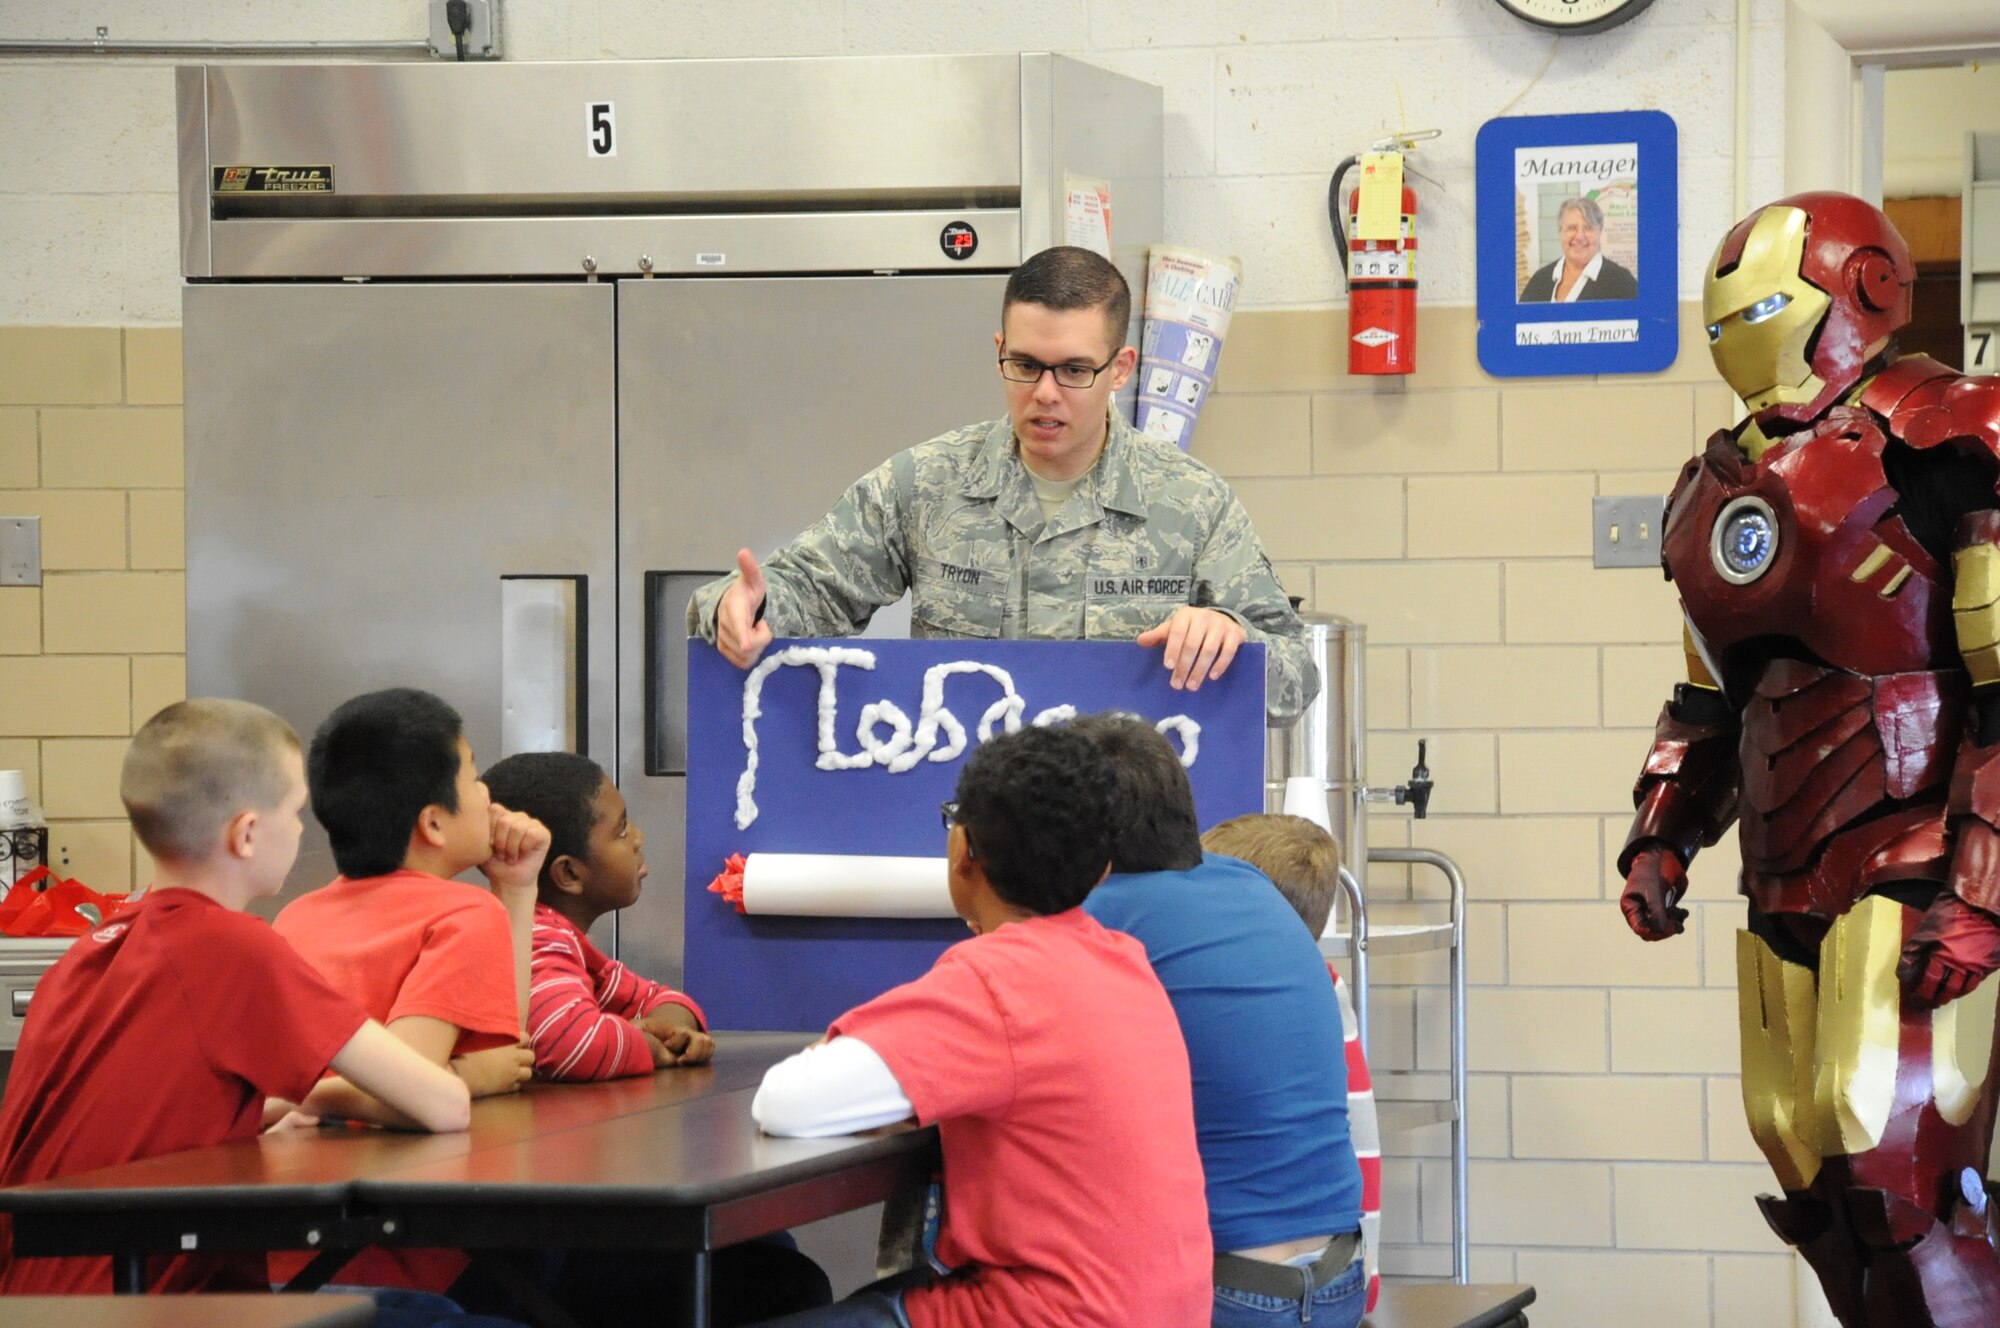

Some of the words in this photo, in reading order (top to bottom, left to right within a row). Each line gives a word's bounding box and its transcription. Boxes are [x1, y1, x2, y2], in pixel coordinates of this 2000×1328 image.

[592, 104, 612, 155] 5
[1521, 157, 1638, 180] Manager
[264, 183, 325, 191] FREEZER
[1518, 331, 1542, 346] Ms.
[1547, 329, 1582, 345] Ann
[1587, 326, 1638, 343] Emory
[1971, 333, 1991, 366] 7
[940, 563, 981, 587] TRYON
[1094, 579, 1118, 595] U.S.
[1121, 579, 1144, 595] AIR
[1147, 579, 1187, 595] FORCE
